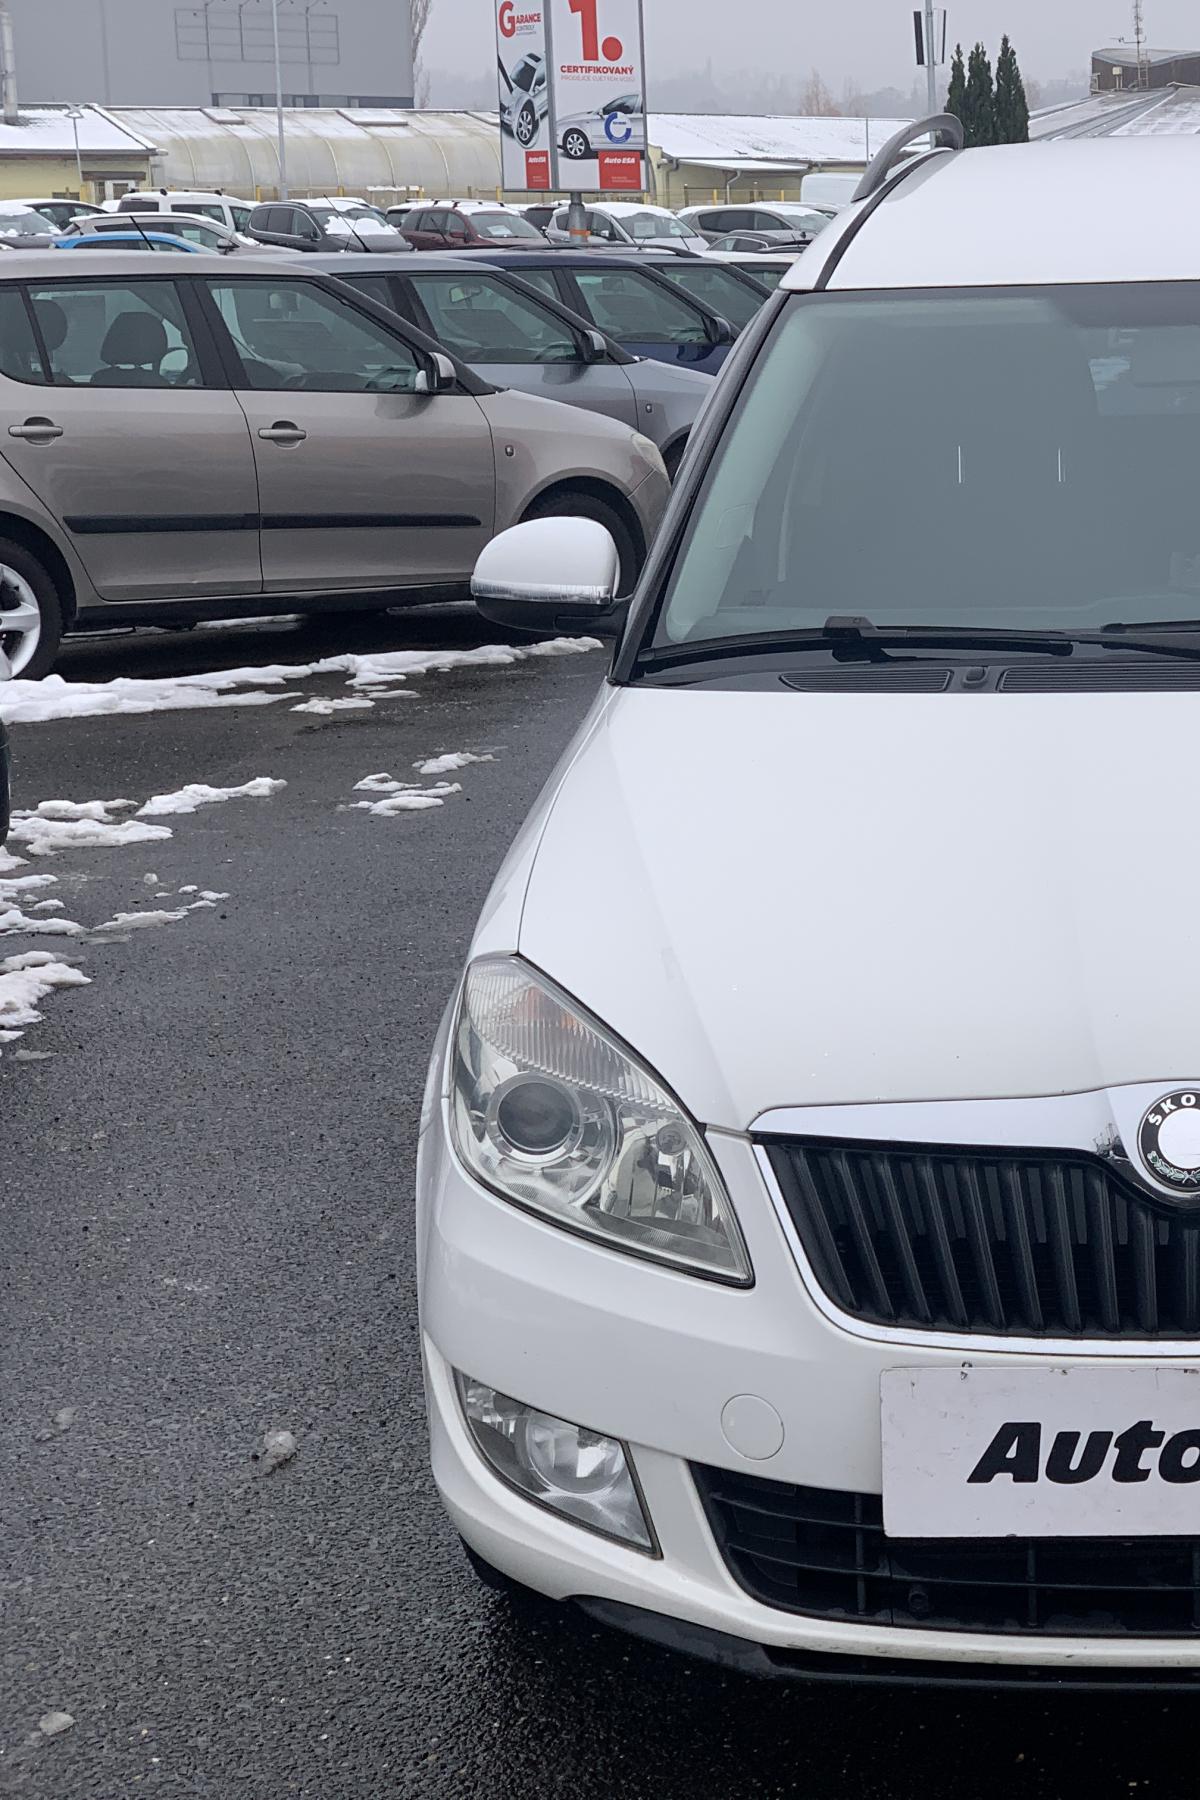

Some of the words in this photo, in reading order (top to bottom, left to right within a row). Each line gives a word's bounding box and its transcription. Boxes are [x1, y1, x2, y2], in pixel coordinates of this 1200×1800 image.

[499, 1, 541, 38] GARANCE
[568, 0, 623, 61] 1.
[560, 65, 634, 75] CERTIFIKOVANÝ
